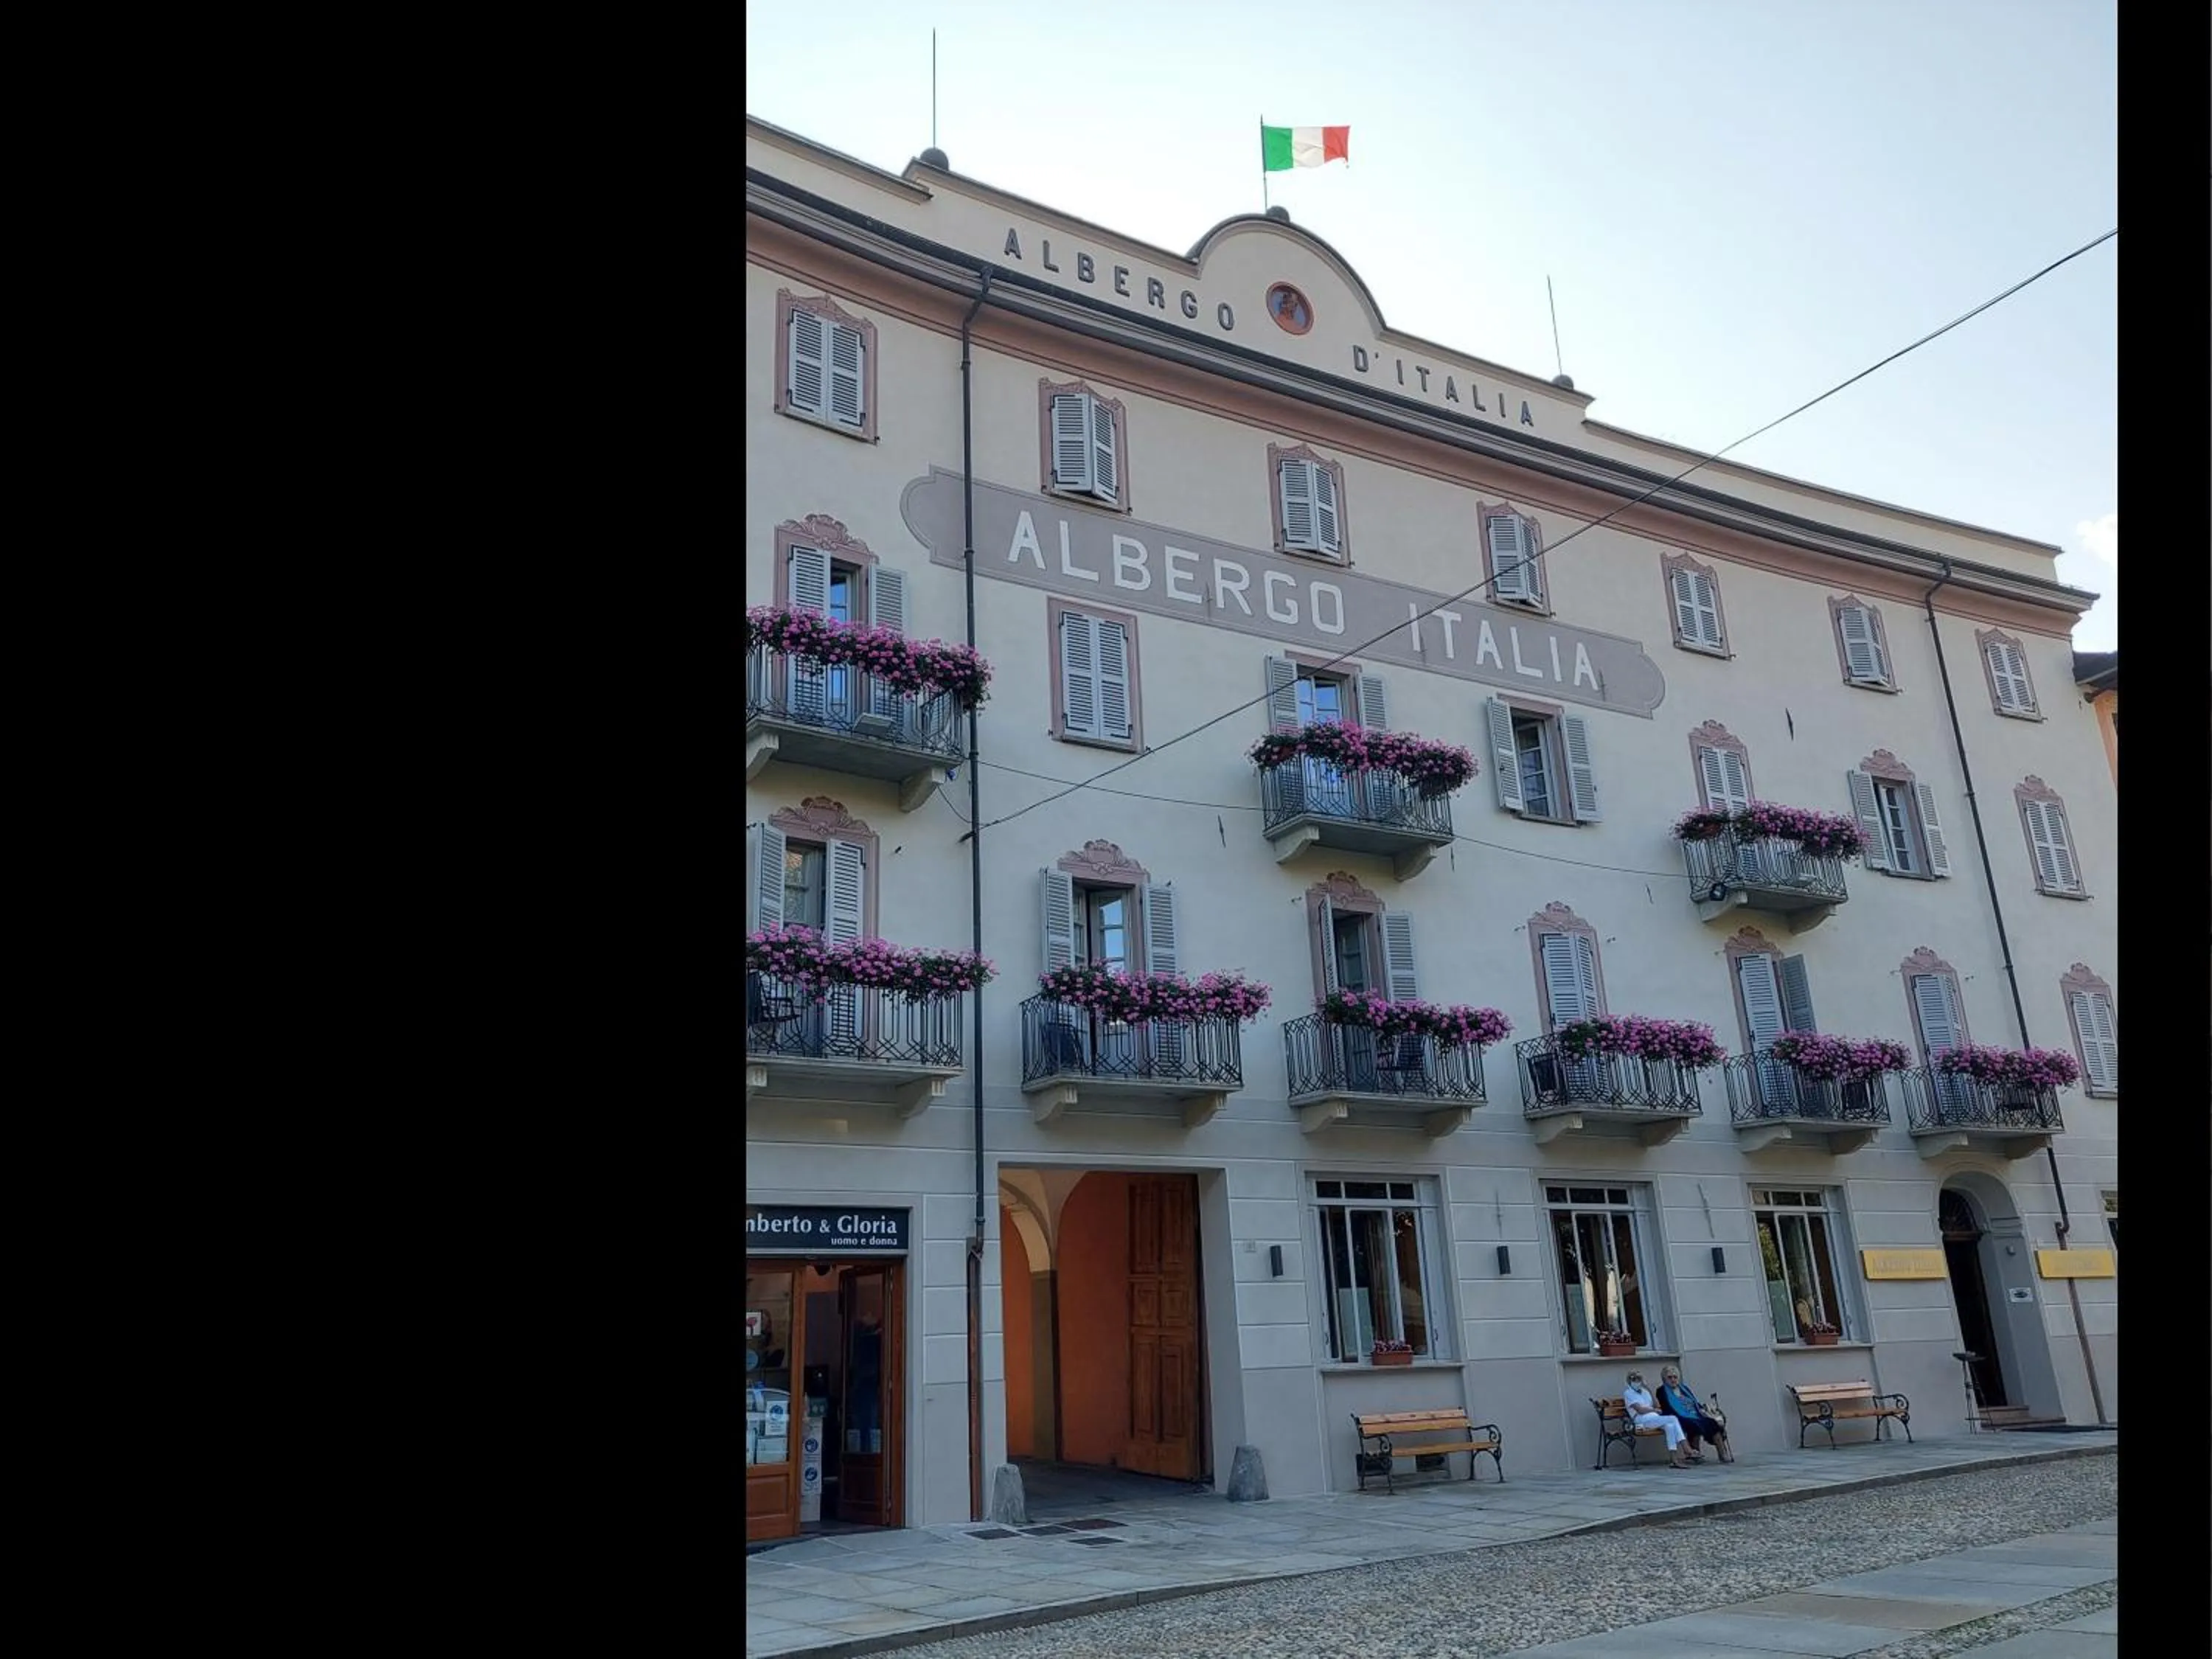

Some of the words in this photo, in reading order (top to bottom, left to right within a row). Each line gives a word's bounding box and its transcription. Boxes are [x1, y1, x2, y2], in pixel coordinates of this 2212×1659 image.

[1004, 227, 1235, 331] ALBERGO
[1352, 344, 1534, 426] D'ITALIA
[1007, 510, 1346, 636] ALBERGO
[1408, 602, 1599, 692] ITALIA
[819, 1219, 831, 1234] &
[837, 1214, 897, 1234] Gloria
[831, 1237, 858, 1245] uomo
[869, 1235, 897, 1245] donna
